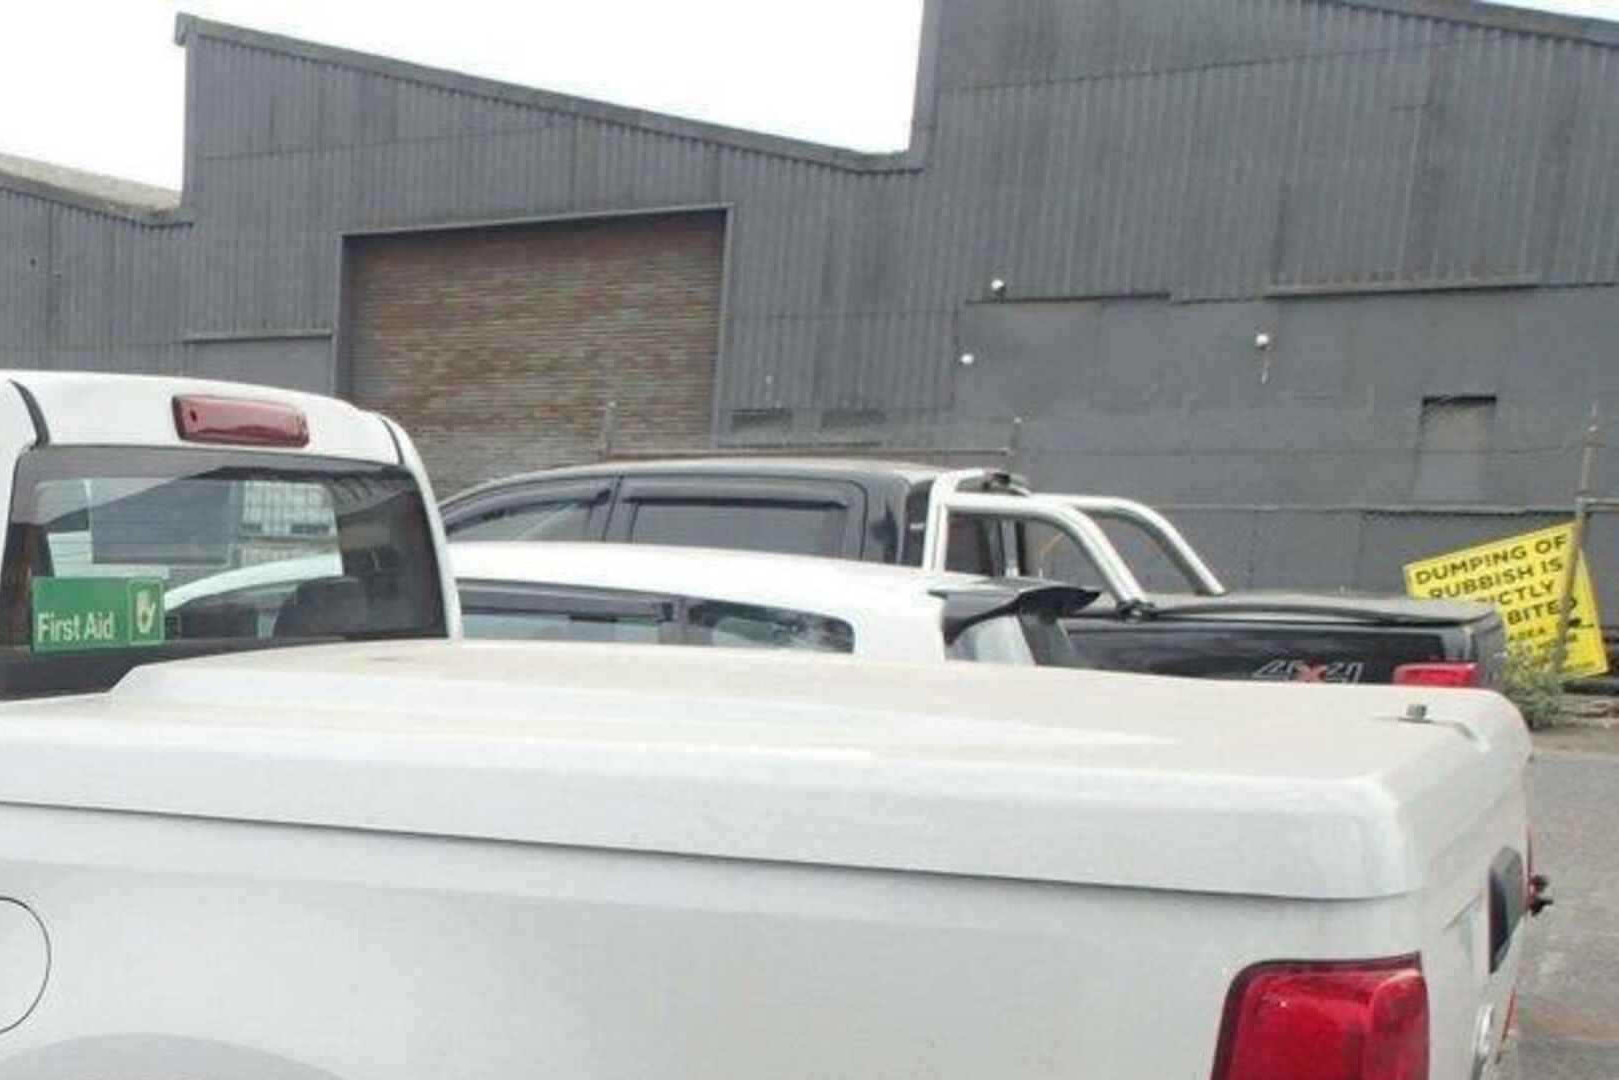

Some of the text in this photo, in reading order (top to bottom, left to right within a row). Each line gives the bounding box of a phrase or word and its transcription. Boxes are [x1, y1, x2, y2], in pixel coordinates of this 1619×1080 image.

[1415, 533, 1568, 585] DUMPING OF
[1428, 557, 1563, 599] RUBBISH IS
[38, 610, 115, 642] First Aid
